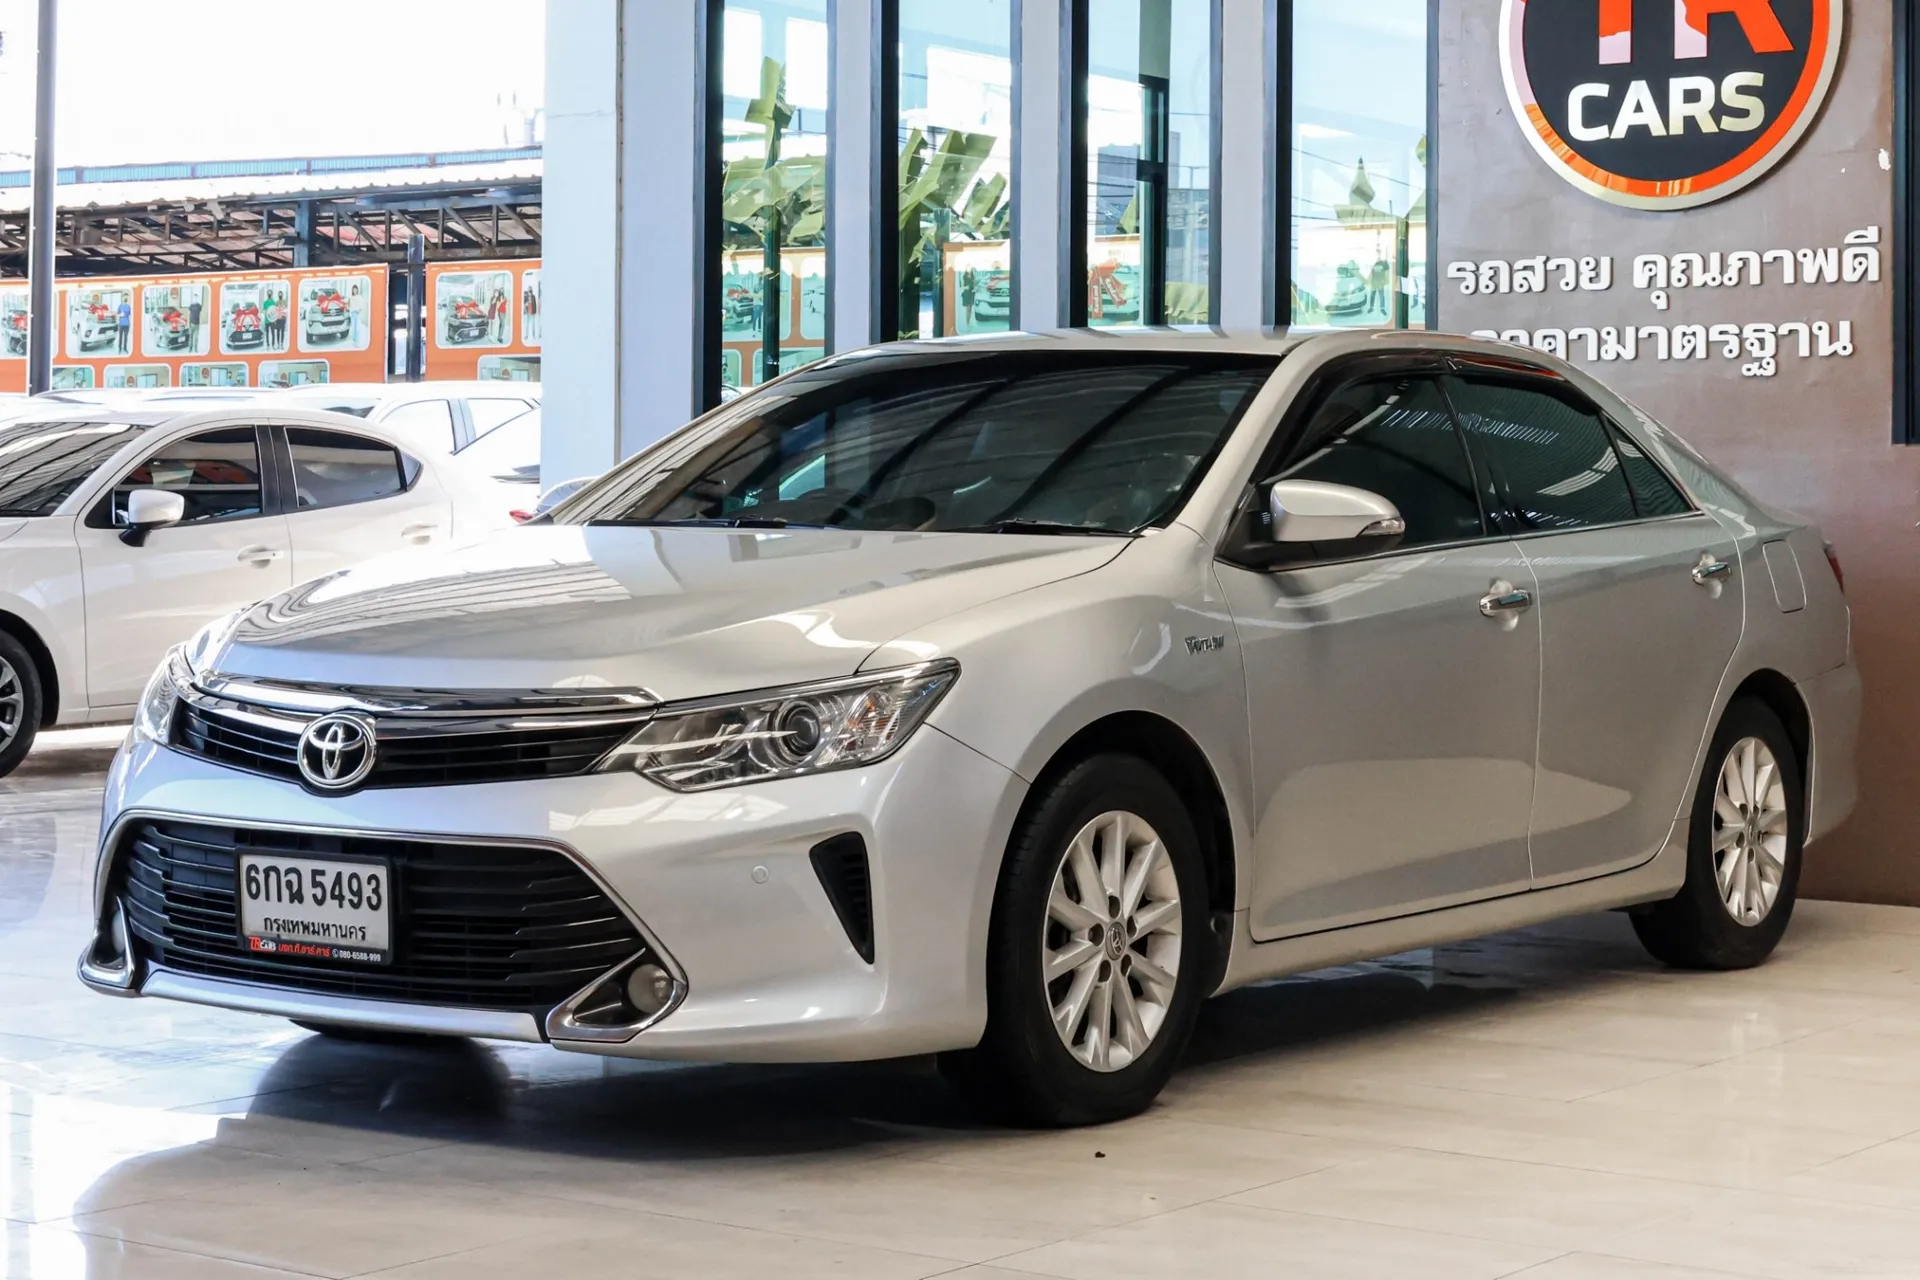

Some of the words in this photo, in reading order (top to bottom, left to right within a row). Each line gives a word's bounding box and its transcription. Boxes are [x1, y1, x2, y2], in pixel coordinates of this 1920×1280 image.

[1567, 71, 1765, 143] CARS
[1447, 253, 1613, 296] รถสวย
[1633, 225, 1881, 311] คุณภาพดี
[245, 864, 304, 904] 6กฉ
[310, 868, 382, 912] 5493
[263, 916, 367, 941] กรุงเทพมหานคร
